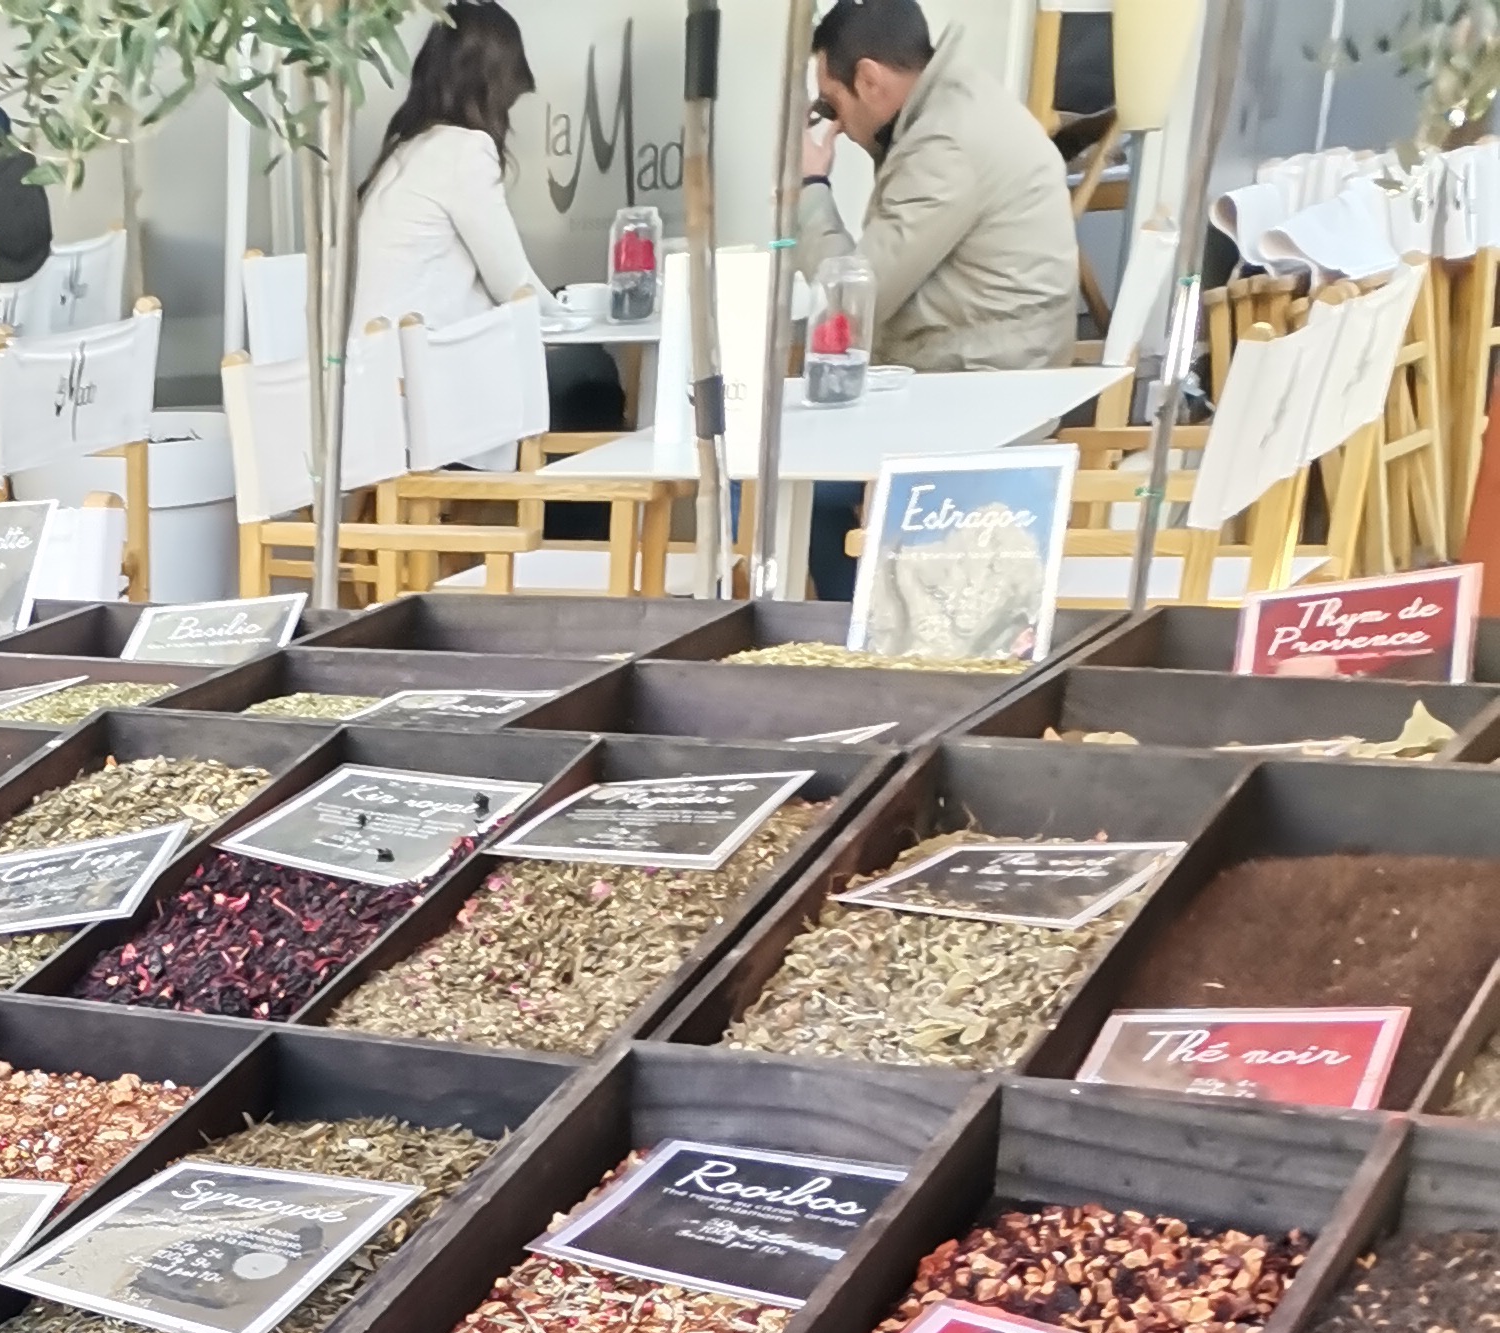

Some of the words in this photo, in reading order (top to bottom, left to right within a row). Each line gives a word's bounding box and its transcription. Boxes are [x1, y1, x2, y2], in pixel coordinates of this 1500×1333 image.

[547, 15, 686, 214] Mad
[901, 484, 1038, 547] Estragon
[1397, 596, 1444, 620] de
[1267, 626, 1432, 656] Provence
[1141, 1029, 1231, 1063] Thé
[1240, 1045, 1352, 1066] noir
[171, 1180, 348, 1223] Syracuse
[674, 1160, 867, 1214] Rooibos
